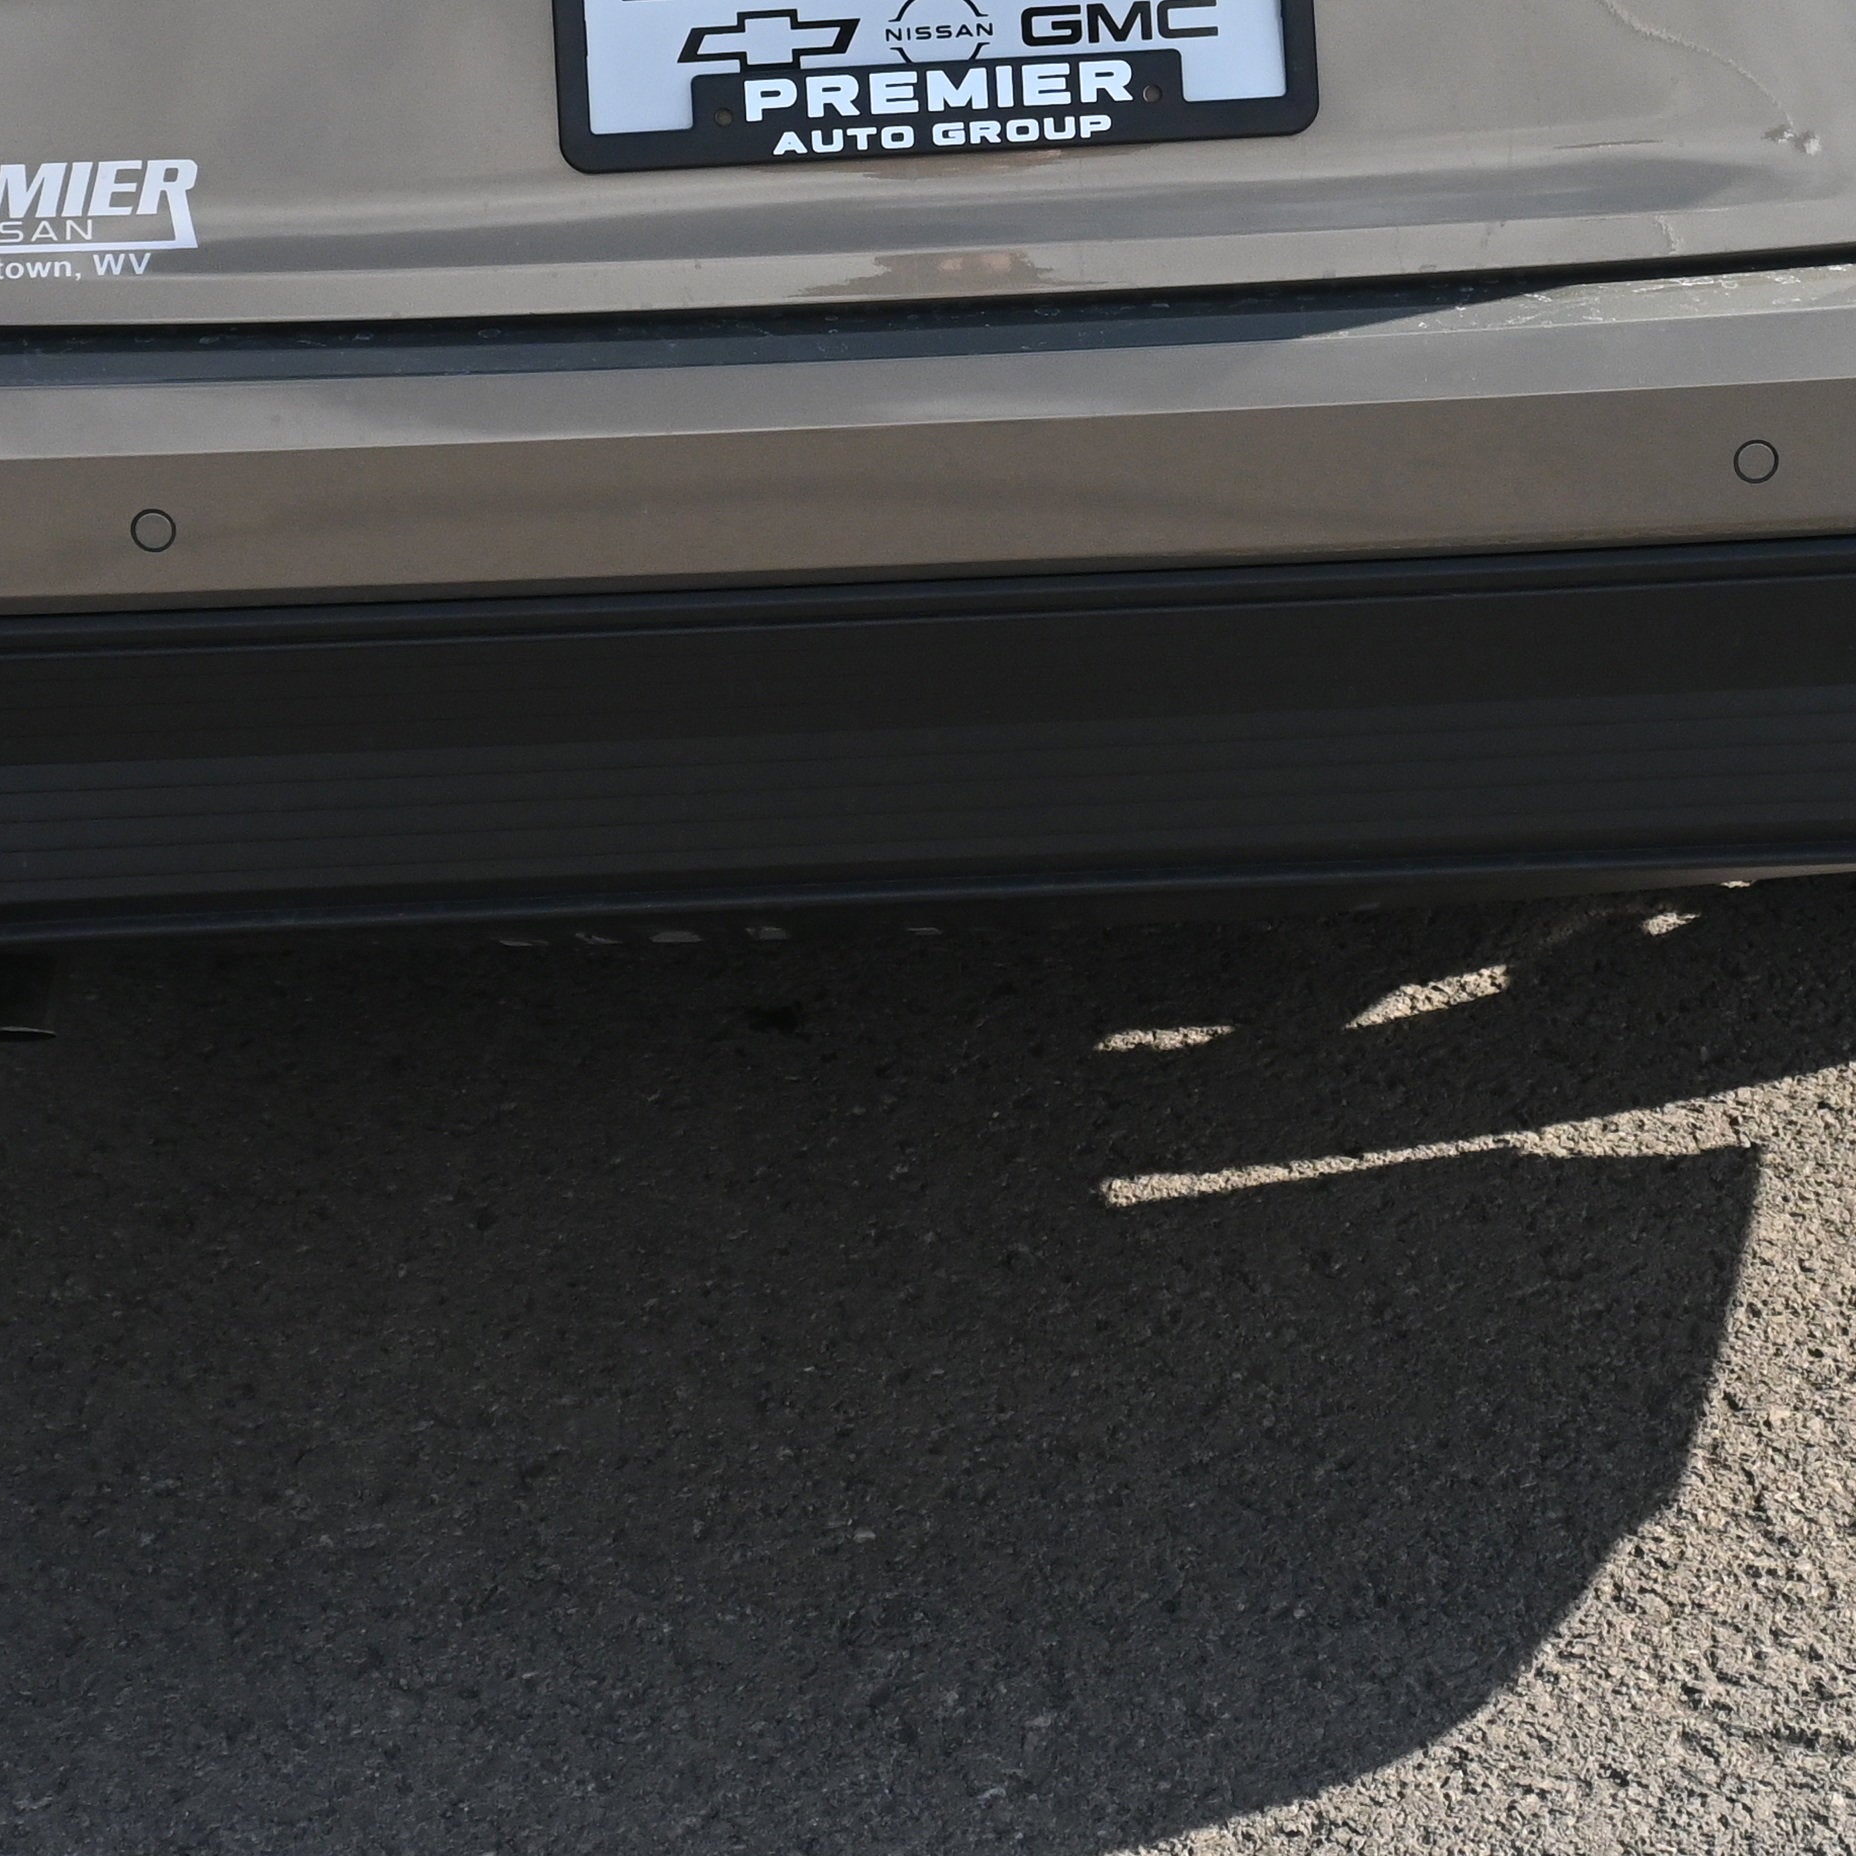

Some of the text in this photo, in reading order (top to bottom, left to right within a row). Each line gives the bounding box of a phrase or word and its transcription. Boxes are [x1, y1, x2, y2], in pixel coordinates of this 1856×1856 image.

[885, 22, 993, 43] NISSAN
[744, 60, 1133, 122] PREMIER
[773, 115, 1112, 156] AUTO GROUP
[94, 253, 151, 277] WV
